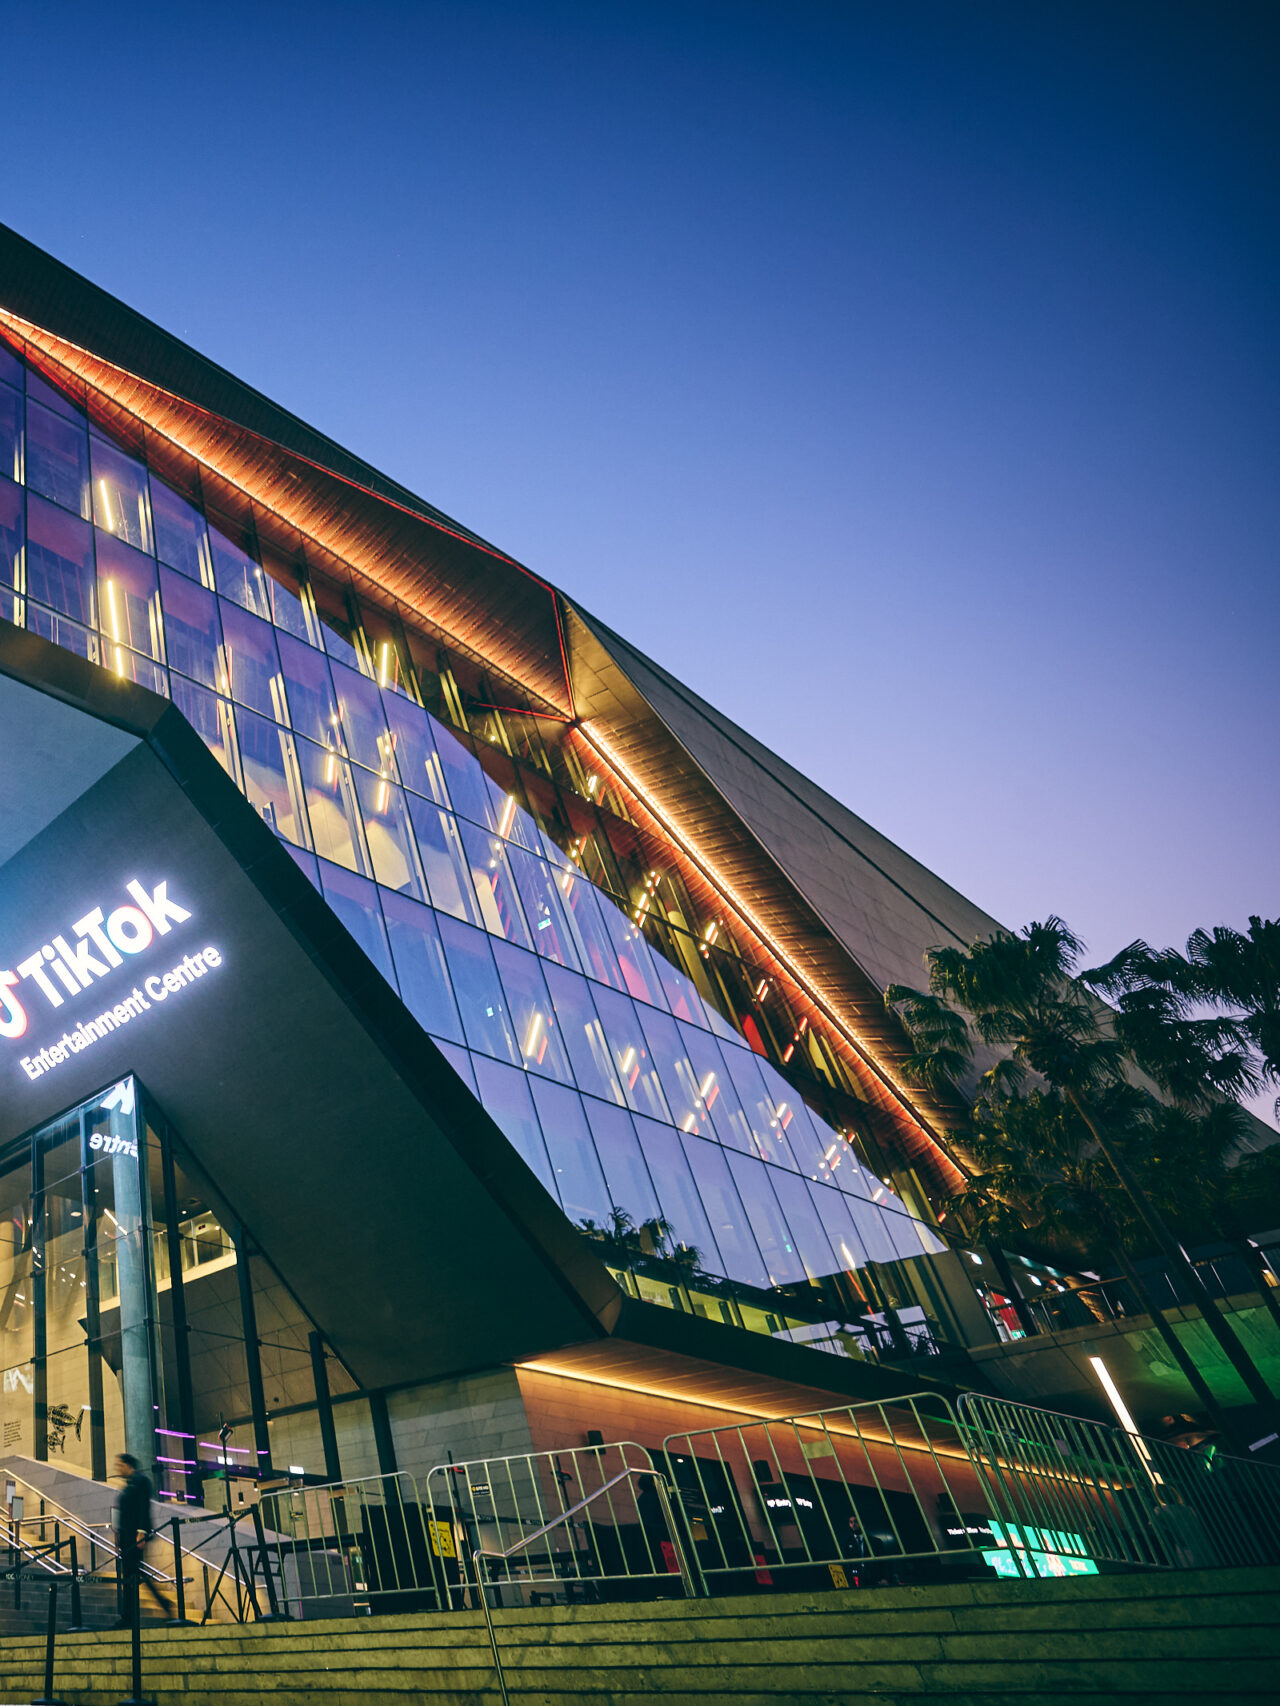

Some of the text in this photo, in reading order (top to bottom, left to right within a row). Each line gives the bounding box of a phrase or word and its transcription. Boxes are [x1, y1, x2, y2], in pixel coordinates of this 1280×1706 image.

[16, 879, 192, 1008] TikTok
[20, 946, 222, 1081] Entertainment Centre
